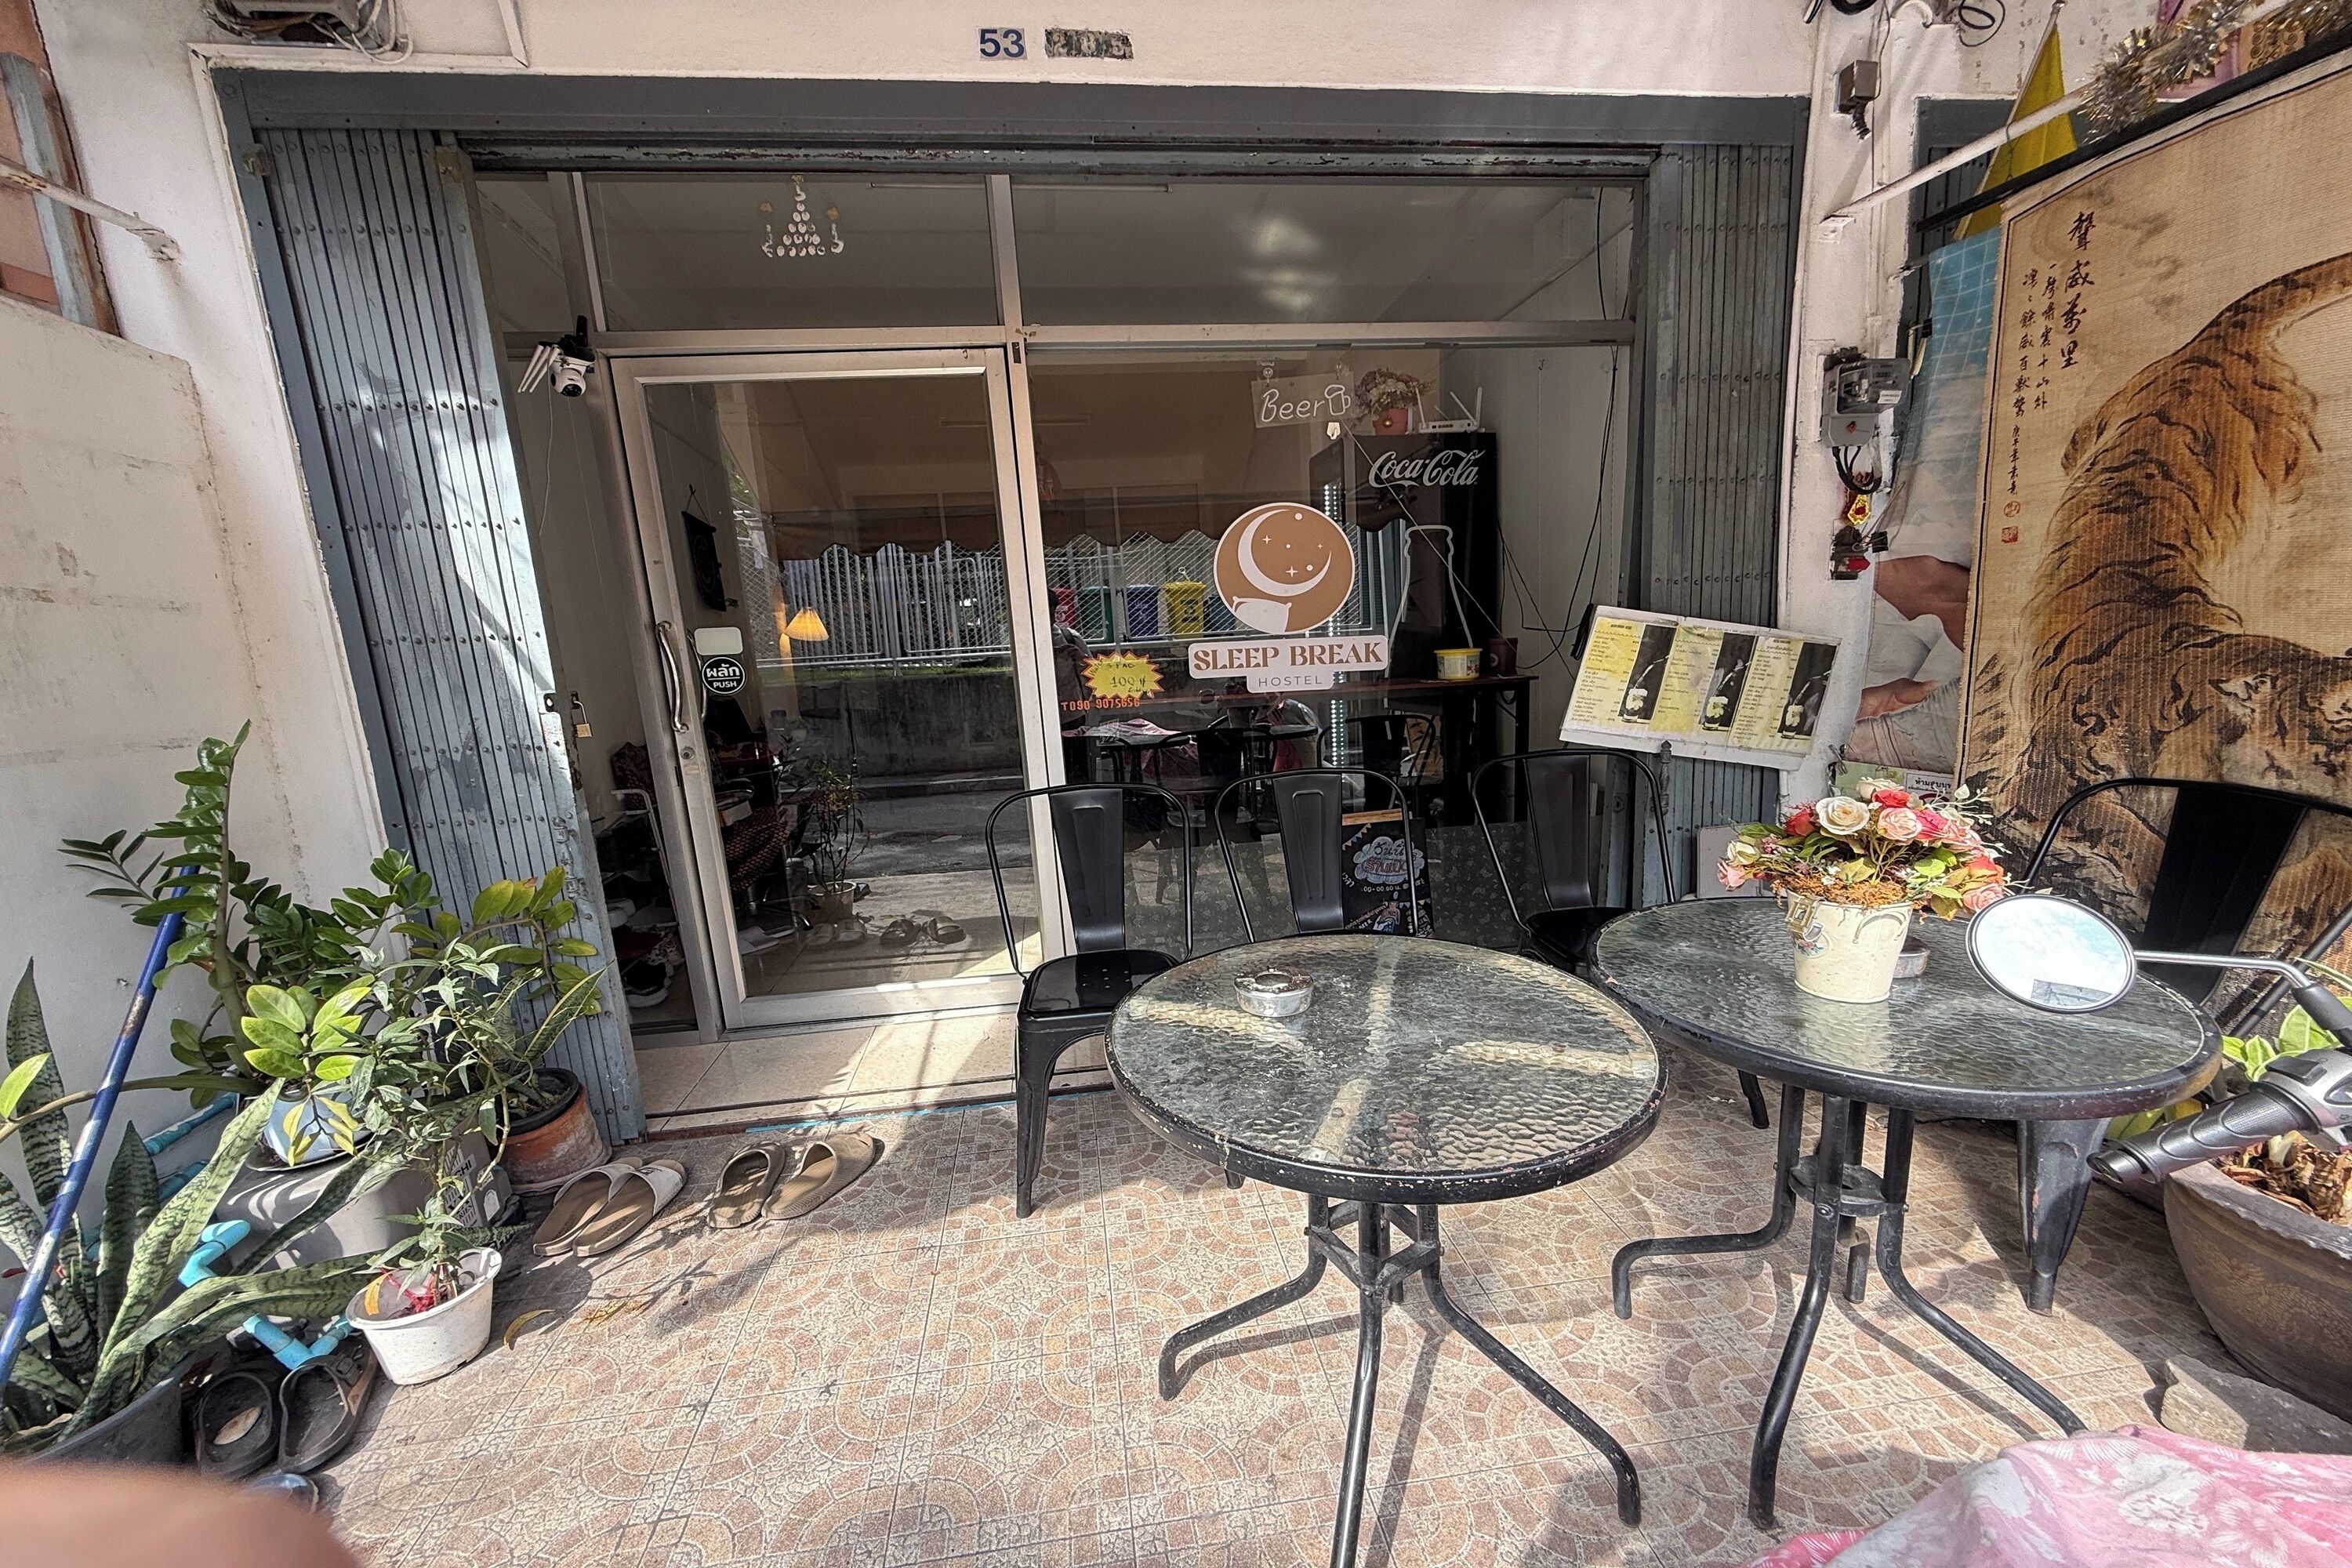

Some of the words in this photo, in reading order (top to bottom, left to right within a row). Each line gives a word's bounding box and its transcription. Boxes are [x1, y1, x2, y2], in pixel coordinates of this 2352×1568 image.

[980, 29, 1025, 57] 53
[1259, 387, 1325, 423] Beer
[1368, 448, 1486, 488] Coca-Cola
[706, 663, 740, 677] ผลัก
[1192, 646, 1279, 672] SLEEP
[1290, 641, 1385, 667] BREAK
[1258, 674, 1323, 688] HOSTEL
[1915, 777, 1951, 790] ห้ามสูบบุห
